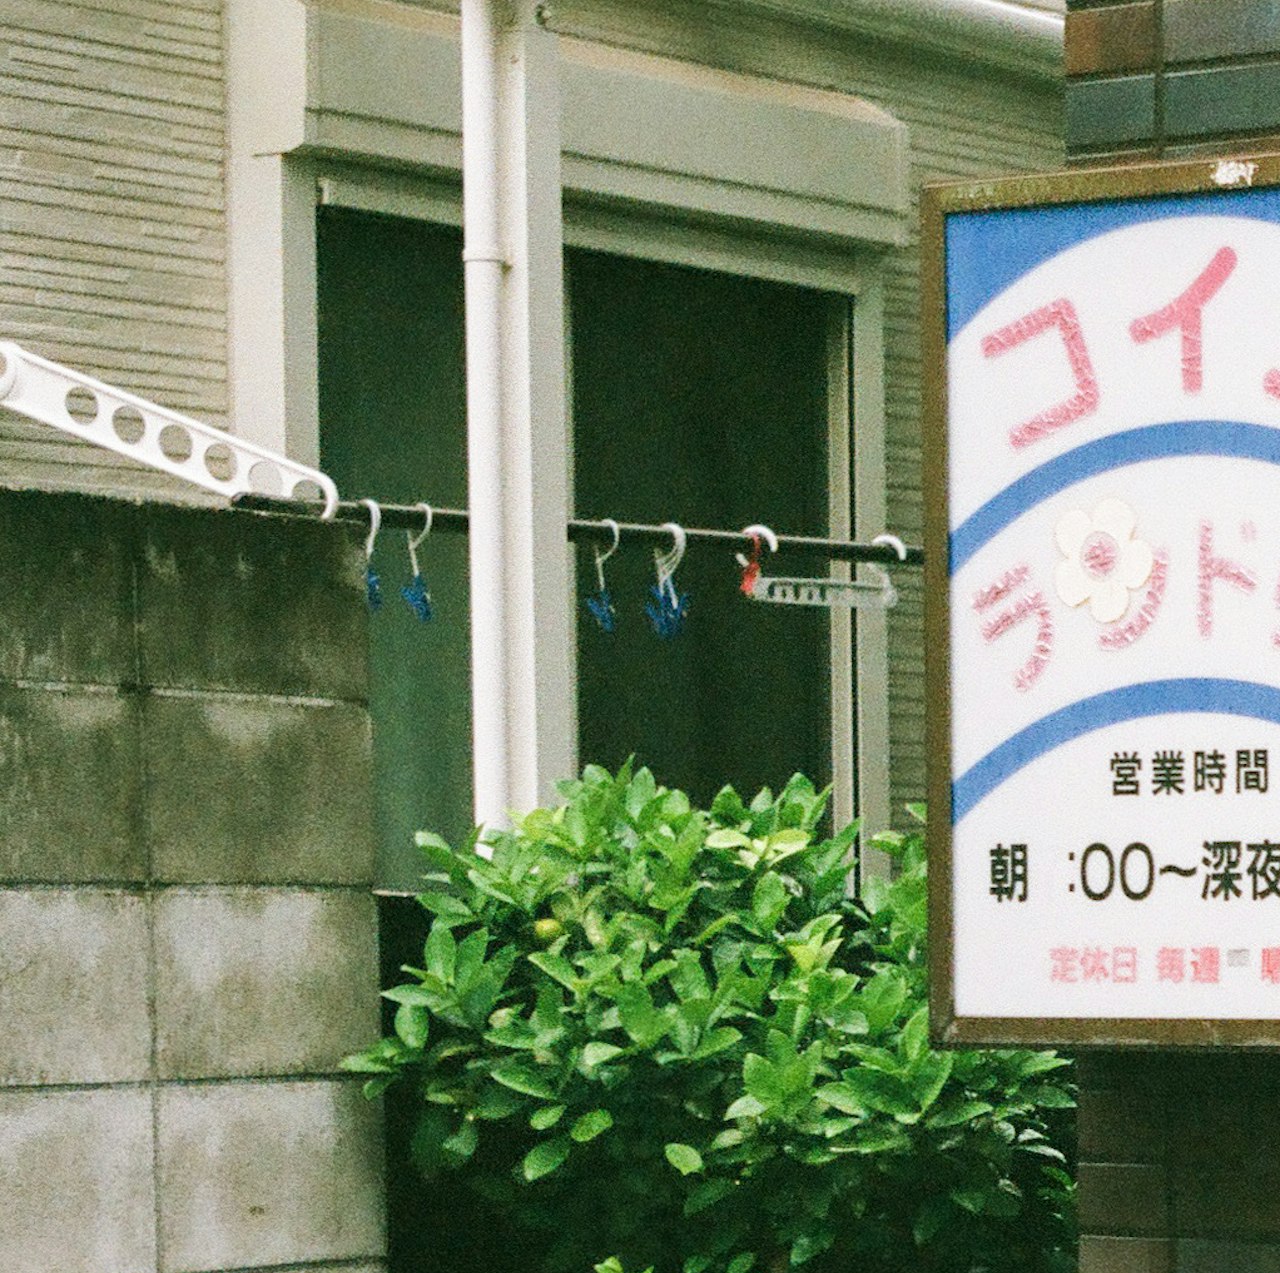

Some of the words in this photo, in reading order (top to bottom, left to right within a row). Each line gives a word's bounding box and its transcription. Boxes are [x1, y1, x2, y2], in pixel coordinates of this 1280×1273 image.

[1109, 748, 1270, 796] 営業時間
[989, 843, 1029, 903] 朝
[1049, 946, 1138, 984] 定休日
